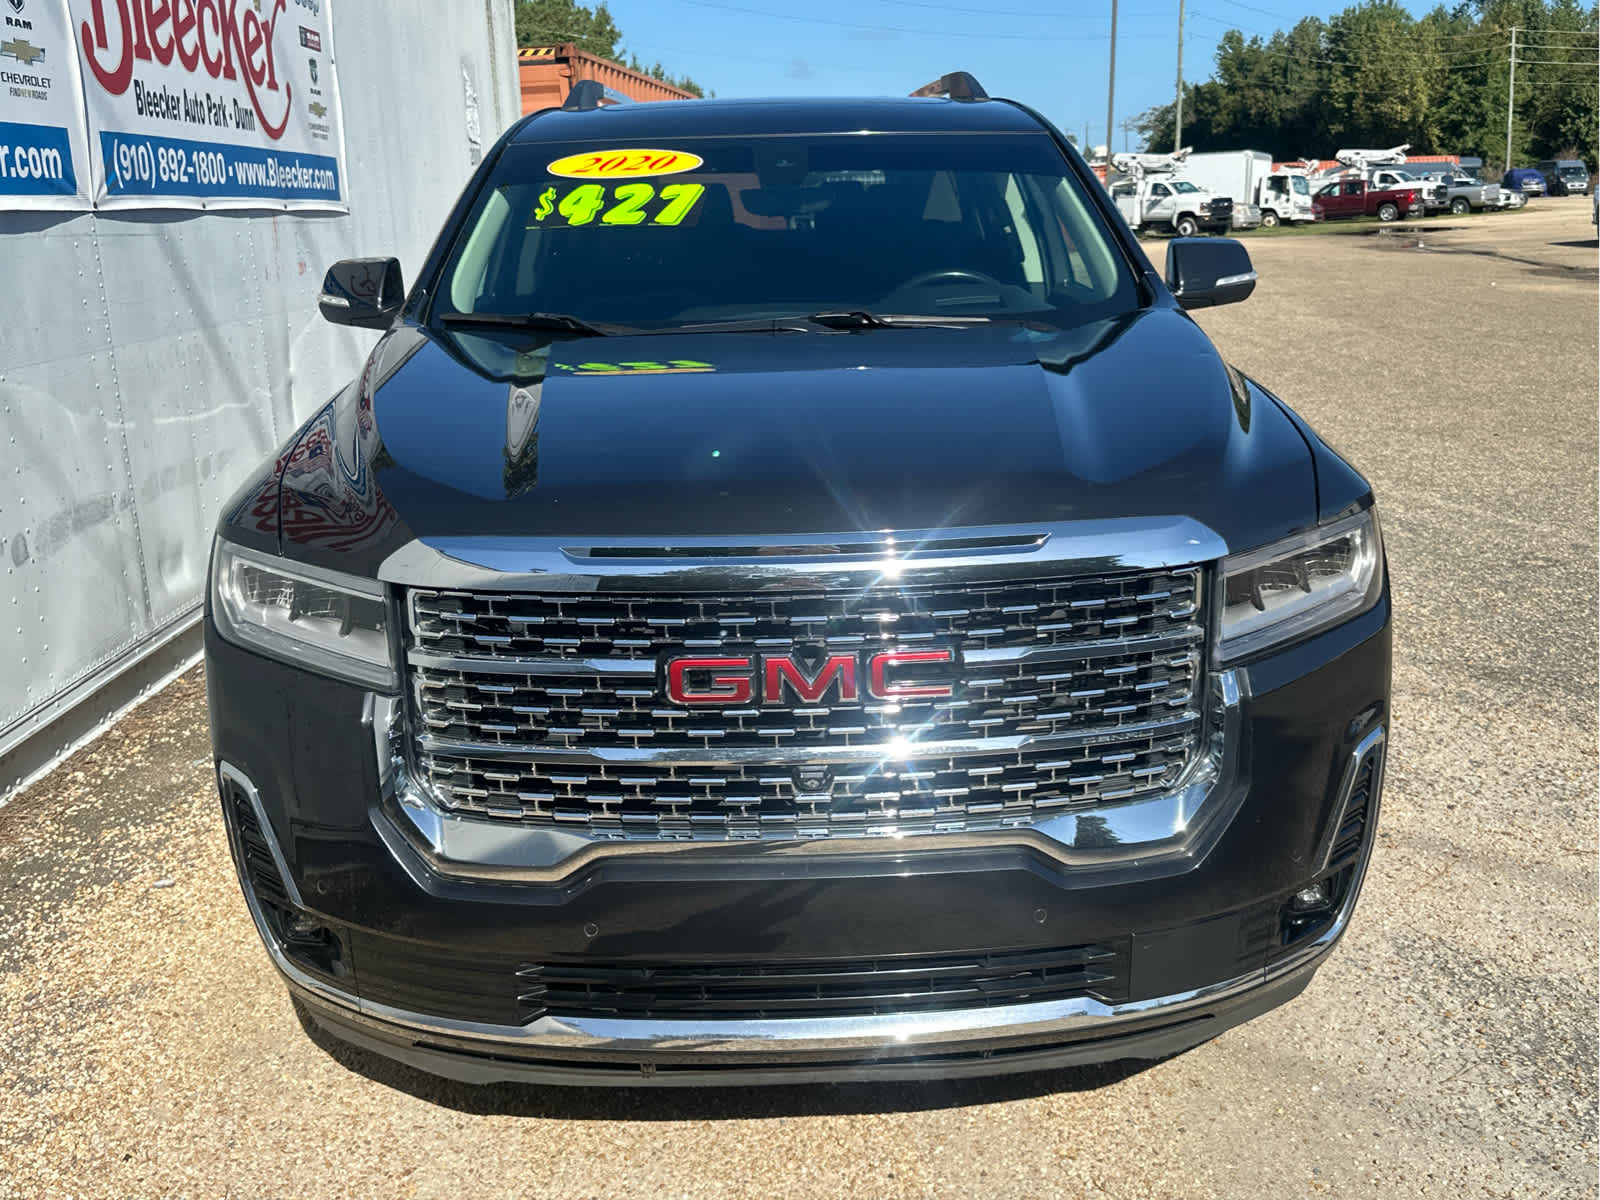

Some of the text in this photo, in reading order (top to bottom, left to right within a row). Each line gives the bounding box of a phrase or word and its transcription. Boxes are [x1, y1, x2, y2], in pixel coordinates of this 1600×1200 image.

[5, 16, 32, 30] RAM
[1, 71, 51, 88] CHEVROLET
[134, 79, 181, 121] Bleecker
[183, 88, 206, 125] Auto
[206, 92, 229, 128] Park
[233, 97, 256, 132] Dunn
[114, 138, 336, 190] (910) 892-1800 www.Bleecker.com
[571, 155, 678, 173] 2020
[534, 183, 705, 226] $427
[665, 648, 956, 705] GMC
